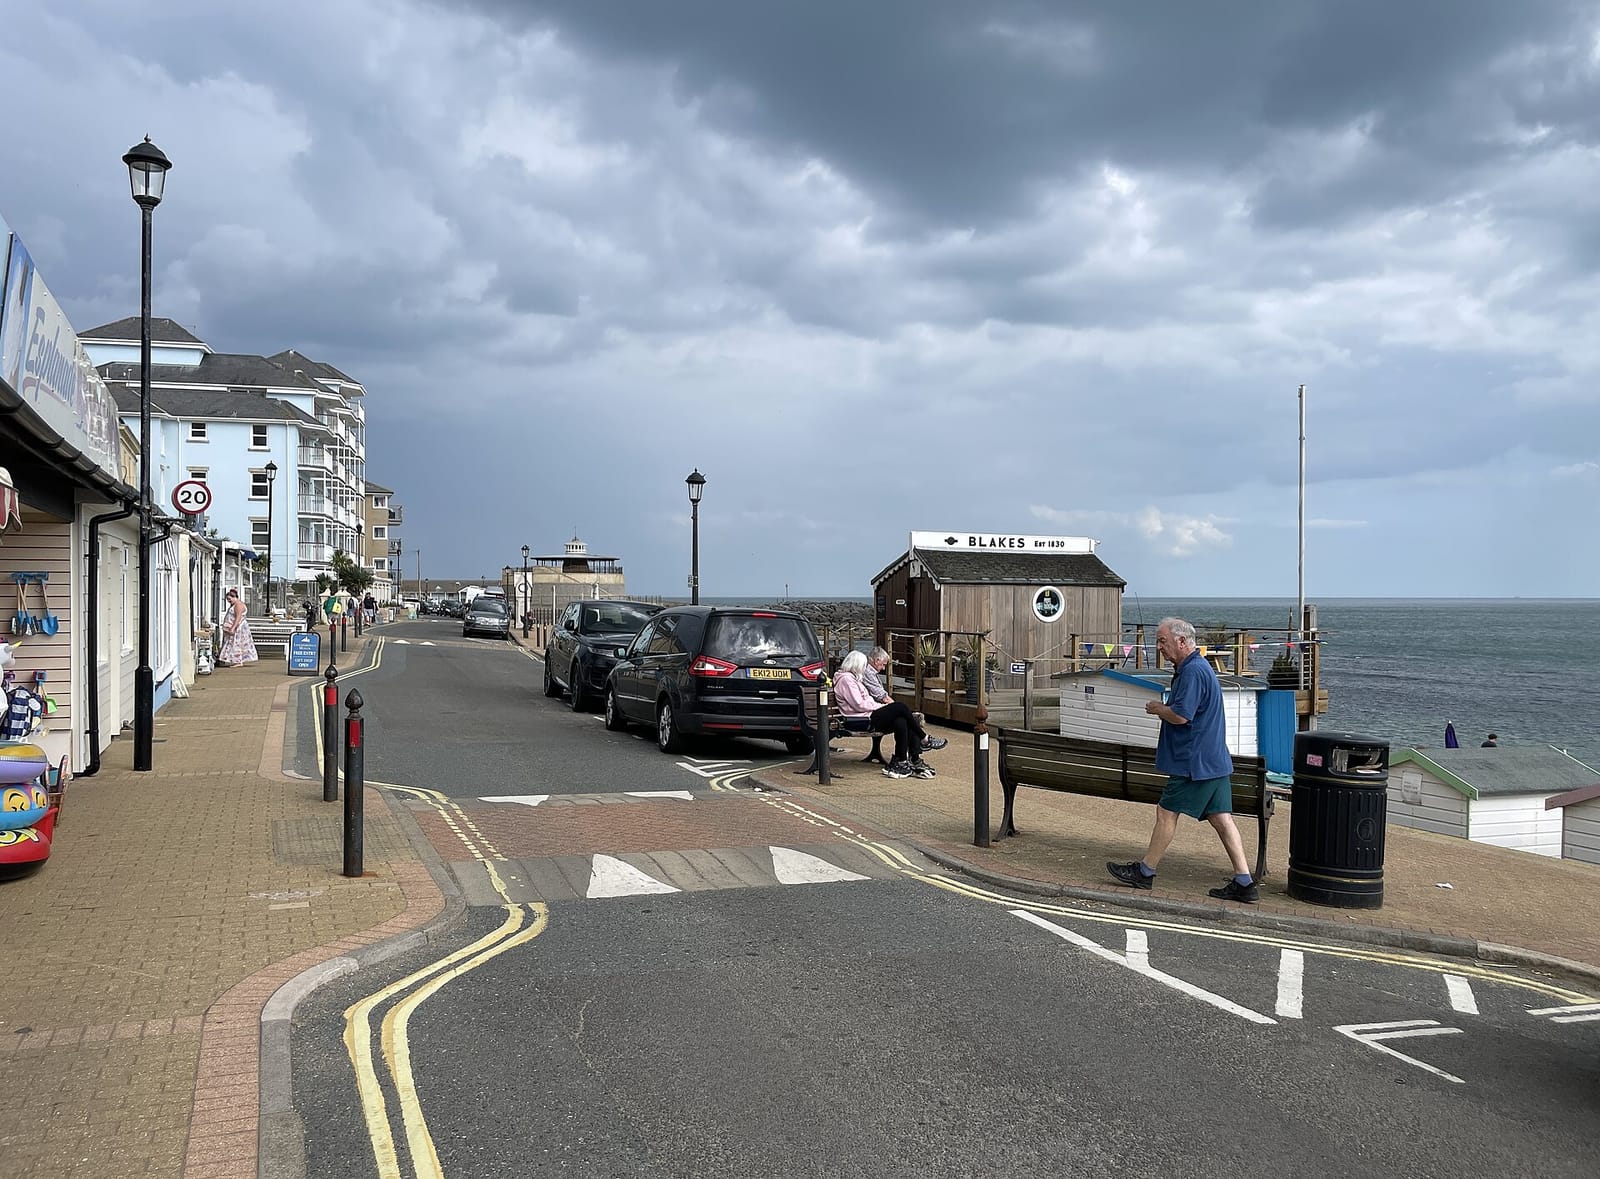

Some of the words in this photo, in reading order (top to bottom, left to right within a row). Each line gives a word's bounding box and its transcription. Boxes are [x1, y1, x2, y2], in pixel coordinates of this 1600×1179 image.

[180, 490, 206, 504] 20
[968, 536, 1025, 548] BLAKES
[1048, 540, 1065, 548] 1830
[752, 669, 770, 678] EK12
